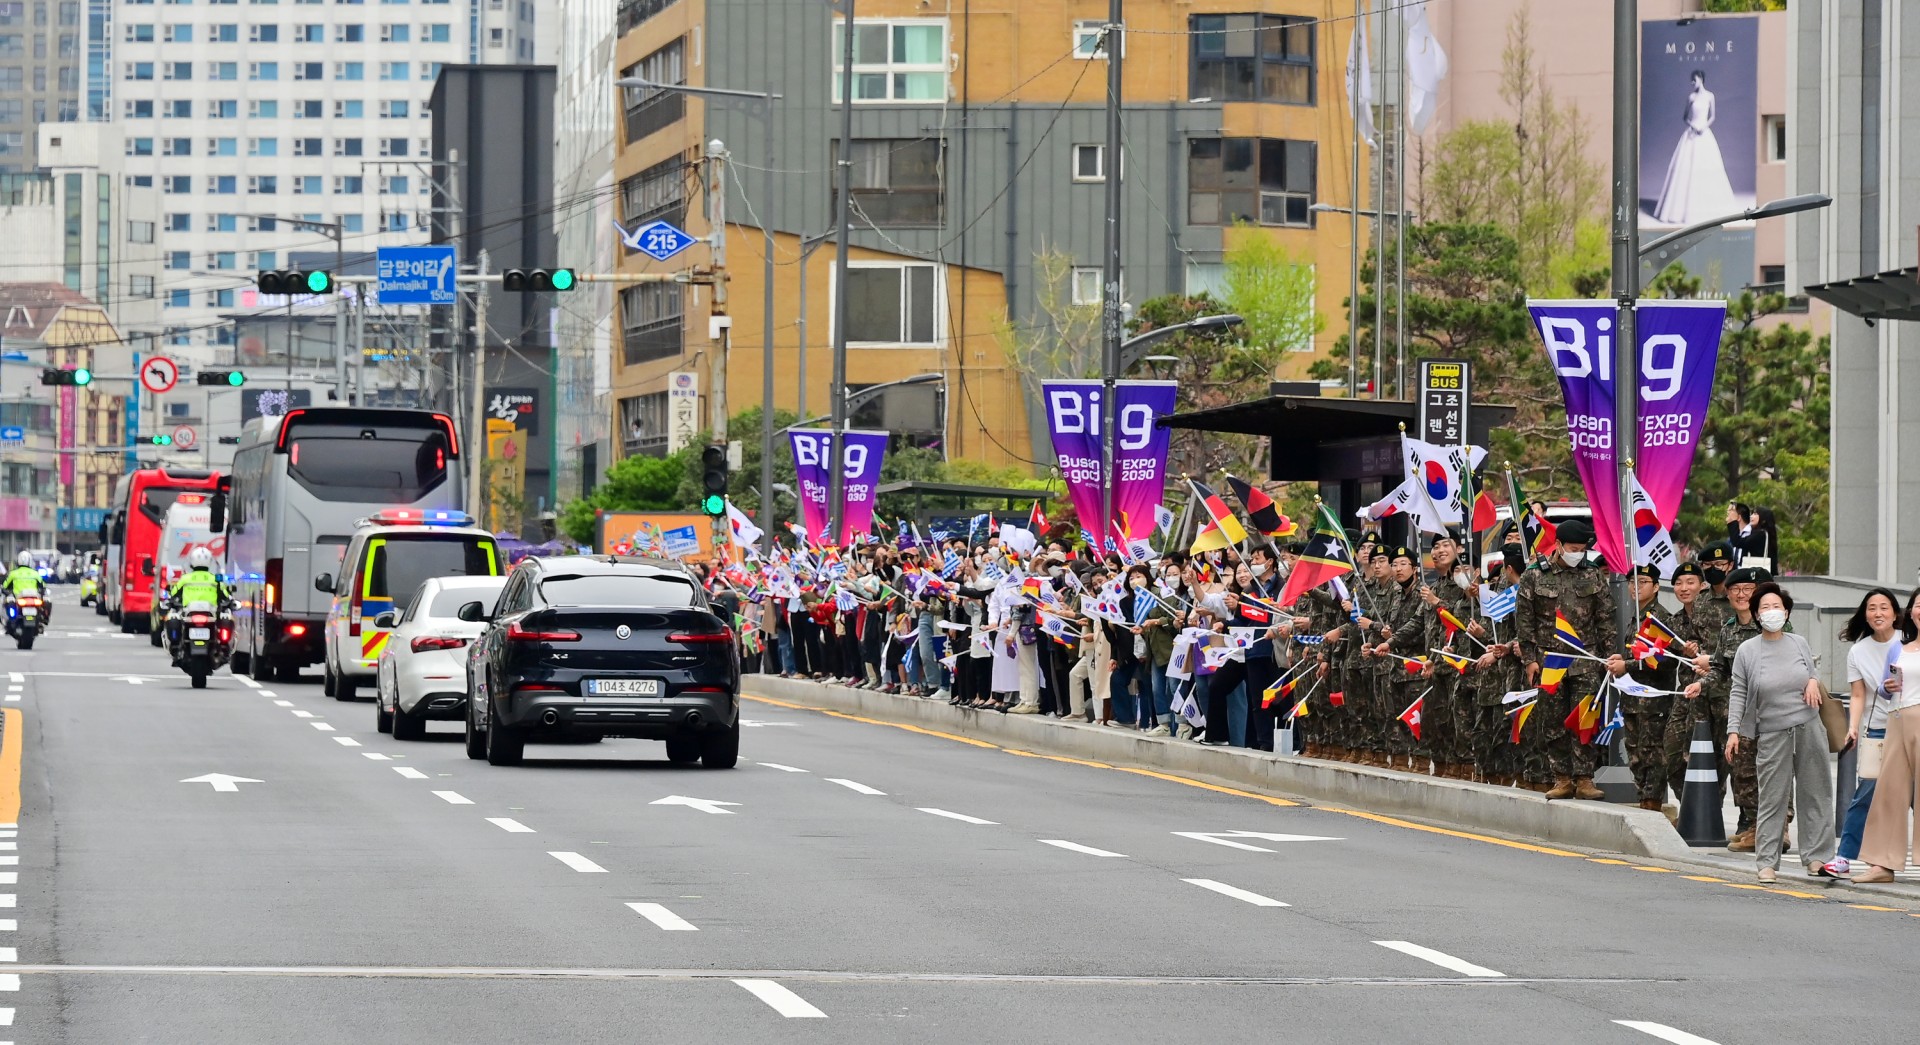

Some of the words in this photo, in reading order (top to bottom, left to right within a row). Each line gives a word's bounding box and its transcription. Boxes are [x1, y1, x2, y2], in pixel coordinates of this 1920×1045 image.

[1665, 40, 1733, 54] MONE
[648, 234, 678, 250] 215
[379, 260, 439, 278] 달맞이길
[430, 290, 454, 301] 150m
[1430, 378, 1458, 388] BUS
[1566, 414, 1611, 431] usan
[1645, 413, 1692, 431] EXPO
[1643, 430, 1690, 447] 2030
[1122, 458, 1157, 470] EXPO
[1121, 469, 1155, 481] 2030
[848, 484, 869, 492] XPO
[847, 493, 867, 501] 030
[628, 681, 656, 693] 4276
